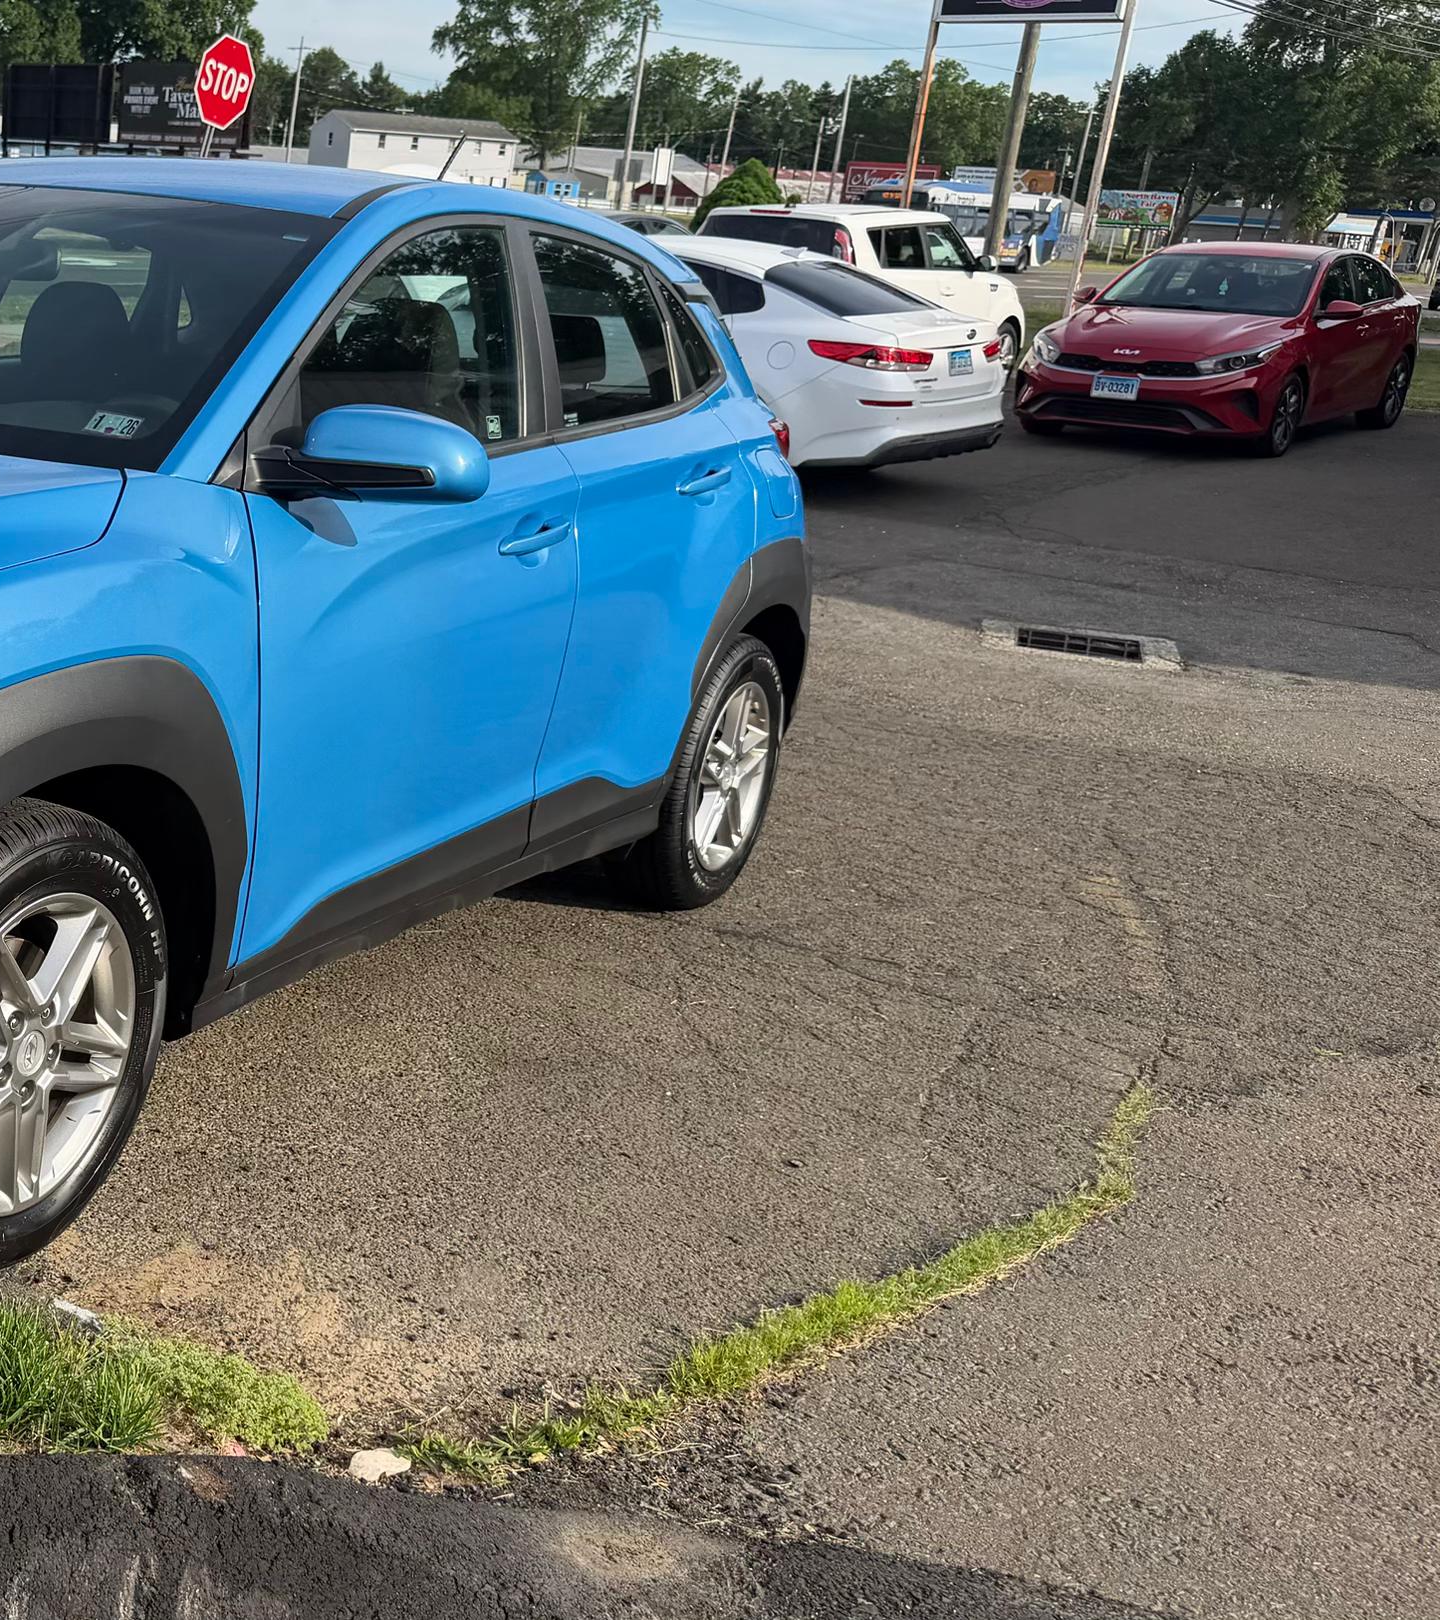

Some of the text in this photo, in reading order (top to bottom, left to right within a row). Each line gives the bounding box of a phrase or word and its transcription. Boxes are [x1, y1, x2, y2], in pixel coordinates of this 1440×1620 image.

[162, 87, 196, 103] Taver
[200, 58, 250, 104] STOP
[120, 419, 140, 435] 26
[61, 850, 156, 922] CAPRICORN
